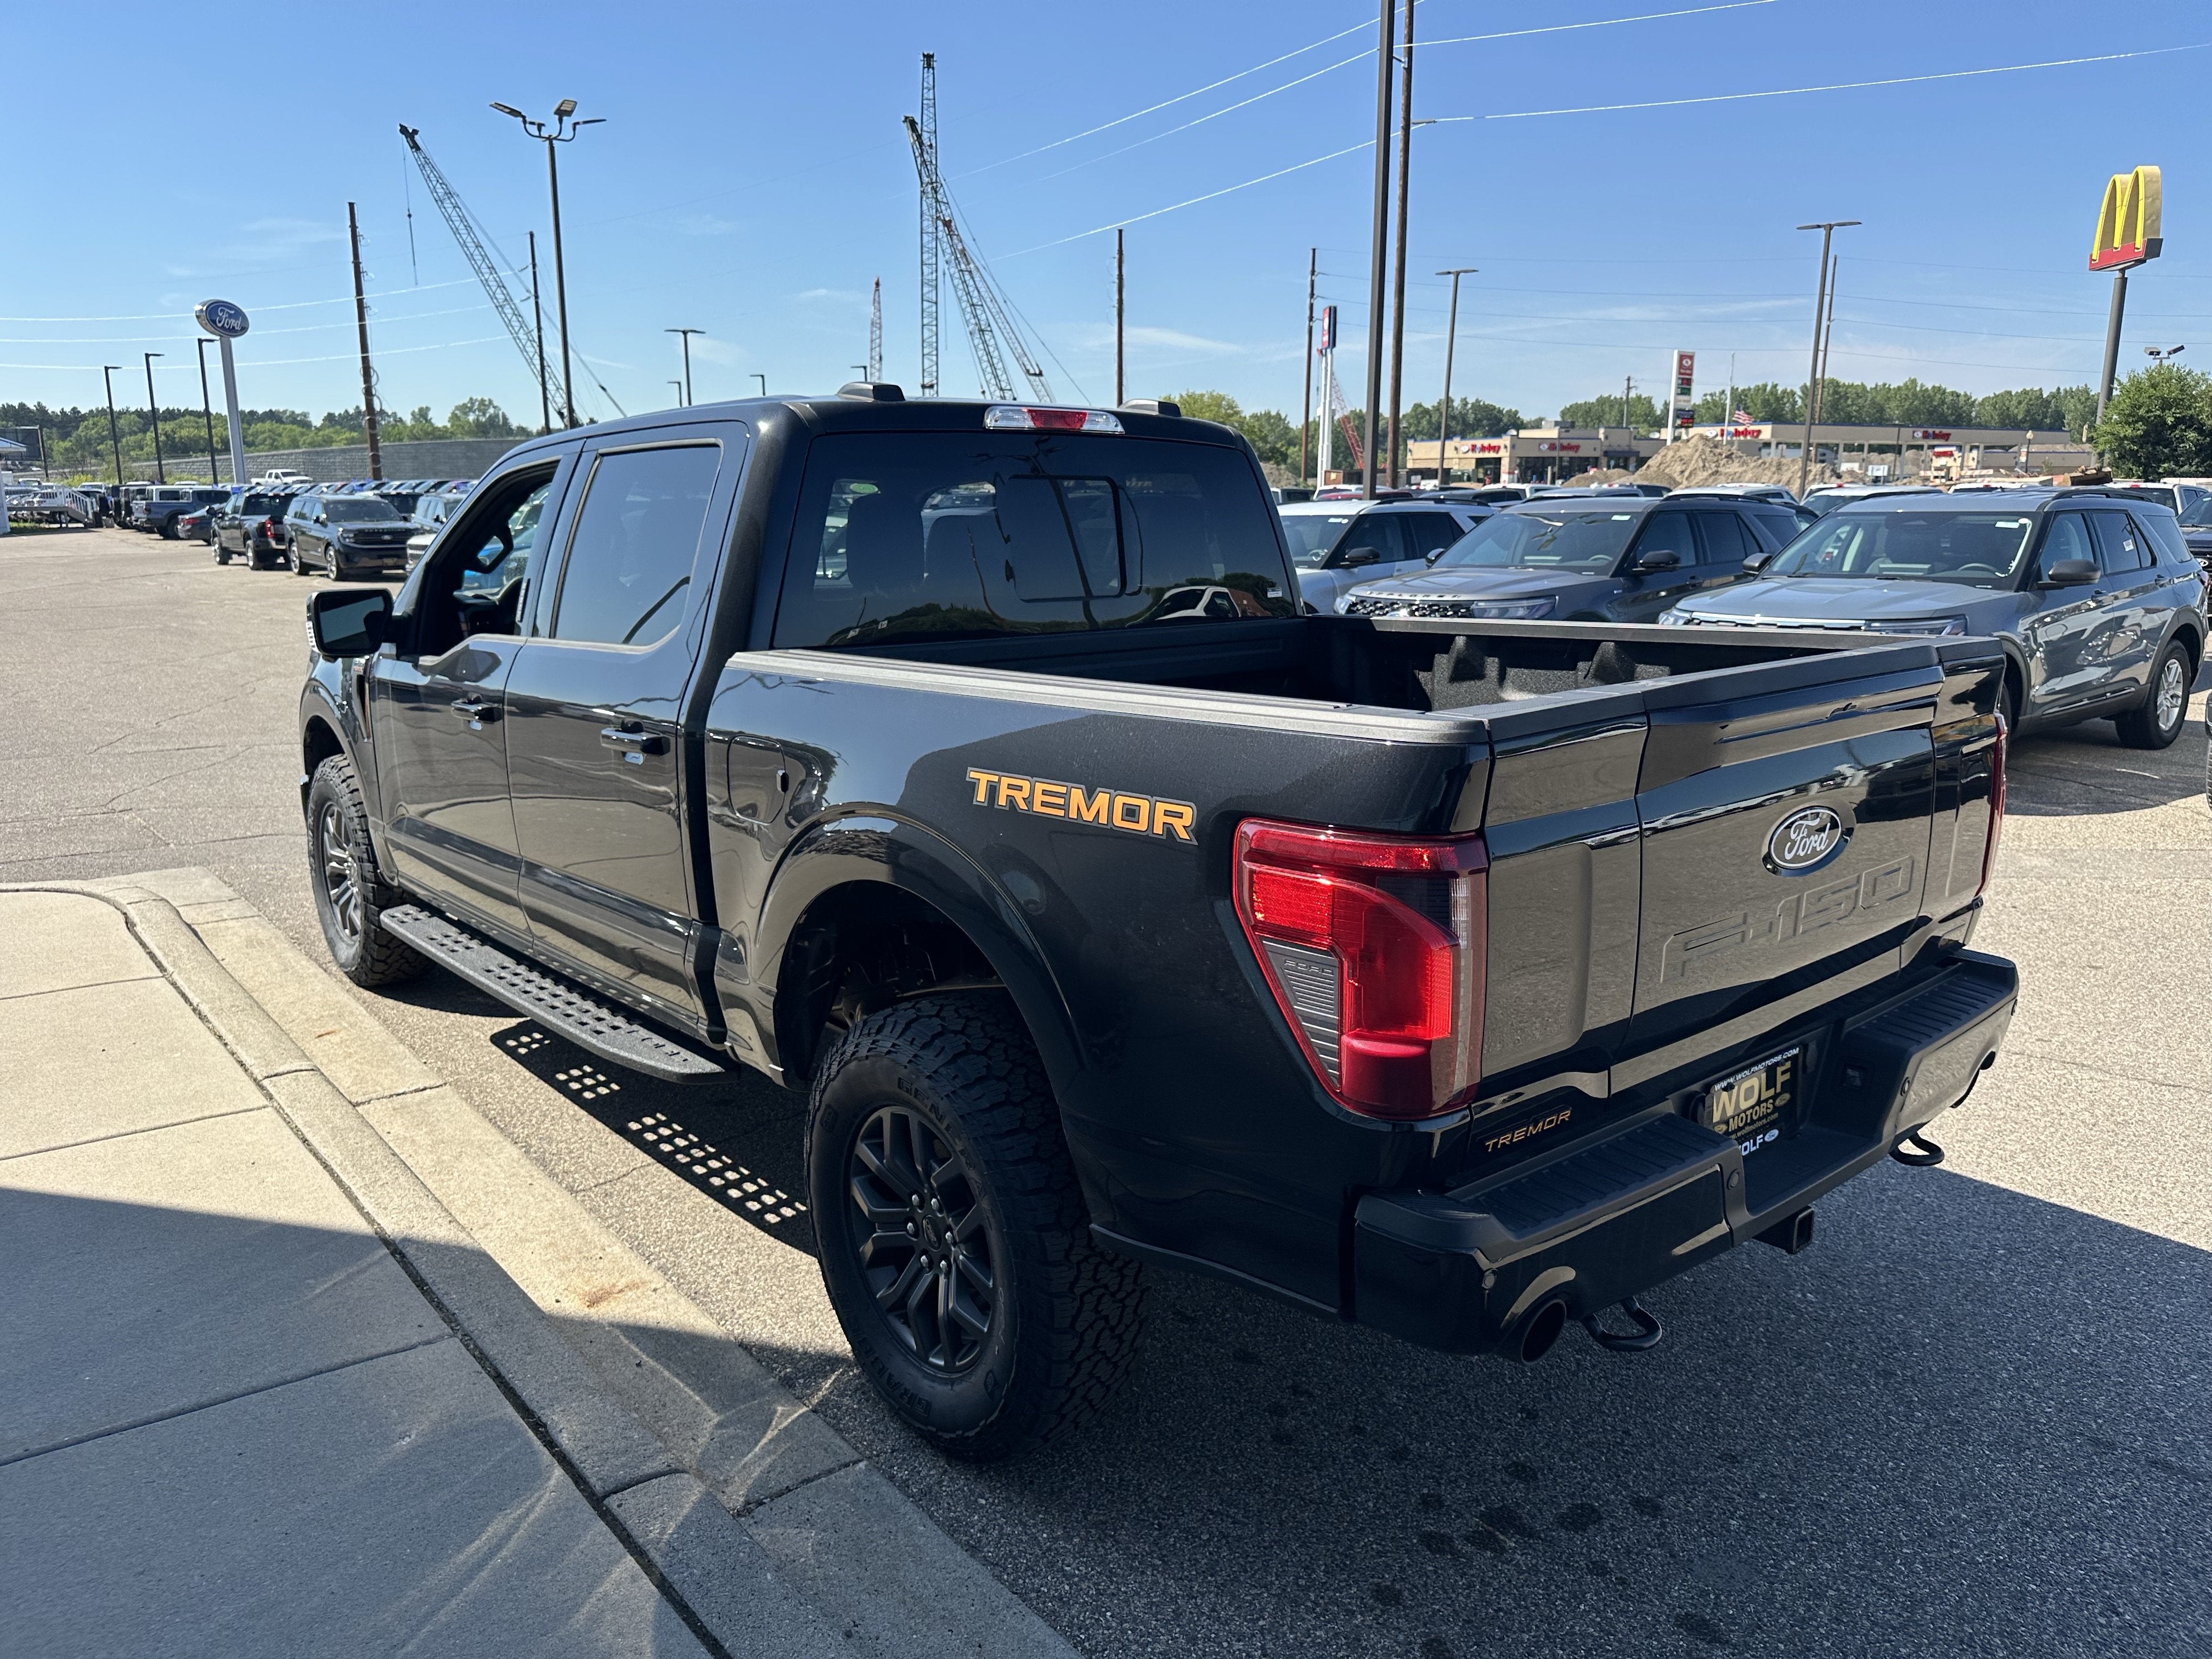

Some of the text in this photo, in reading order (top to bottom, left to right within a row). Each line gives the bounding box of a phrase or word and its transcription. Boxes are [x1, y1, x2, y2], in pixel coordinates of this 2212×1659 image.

[216, 307, 241, 330] Ford
[967, 769, 1196, 843] TREMOR
[1784, 817, 1831, 860] Ford
[1284, 960, 1334, 977] FORD
[1712, 1061, 1791, 1124] WOLF
[1485, 1110, 1572, 1152] TREMOR
[1729, 1099, 1774, 1132] MOTORS
[1739, 1134, 1763, 1156] OLF
